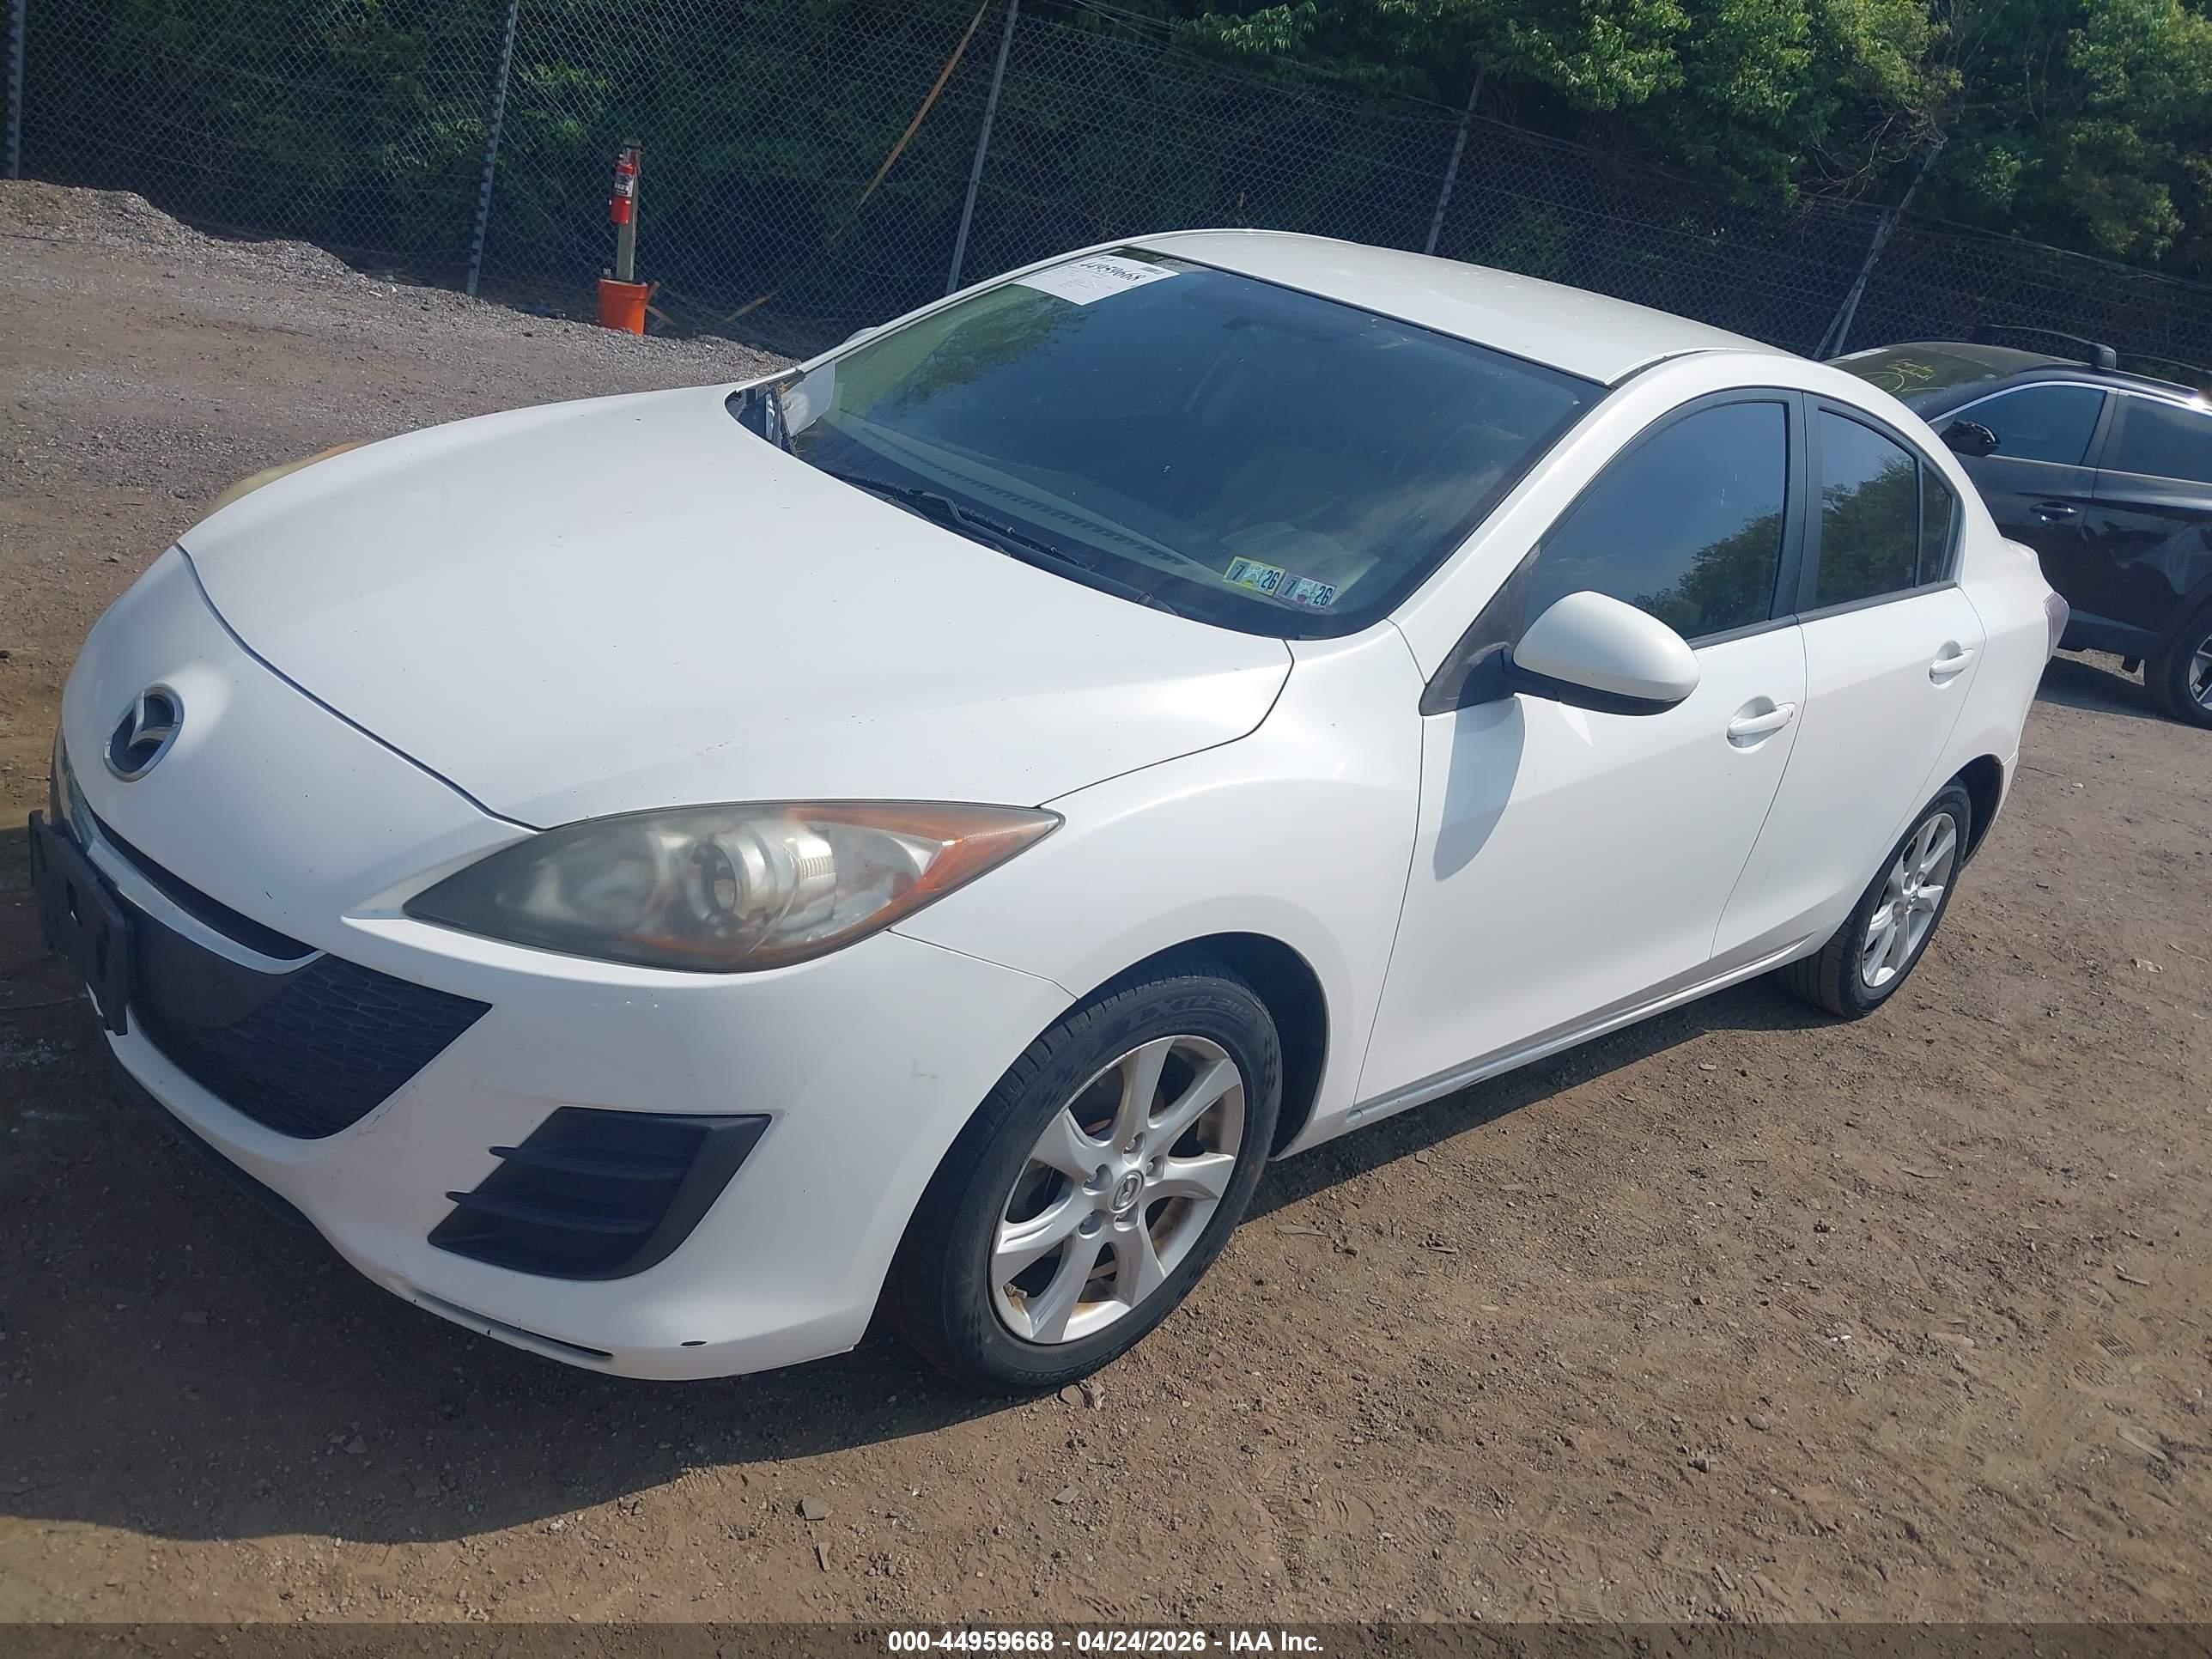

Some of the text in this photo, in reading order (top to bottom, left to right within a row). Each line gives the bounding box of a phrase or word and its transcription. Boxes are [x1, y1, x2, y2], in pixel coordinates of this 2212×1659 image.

[1079, 262, 1146, 281] 44959668
[1232, 564, 1280, 590] 7 26
[1284, 579, 1333, 606] 7 26
